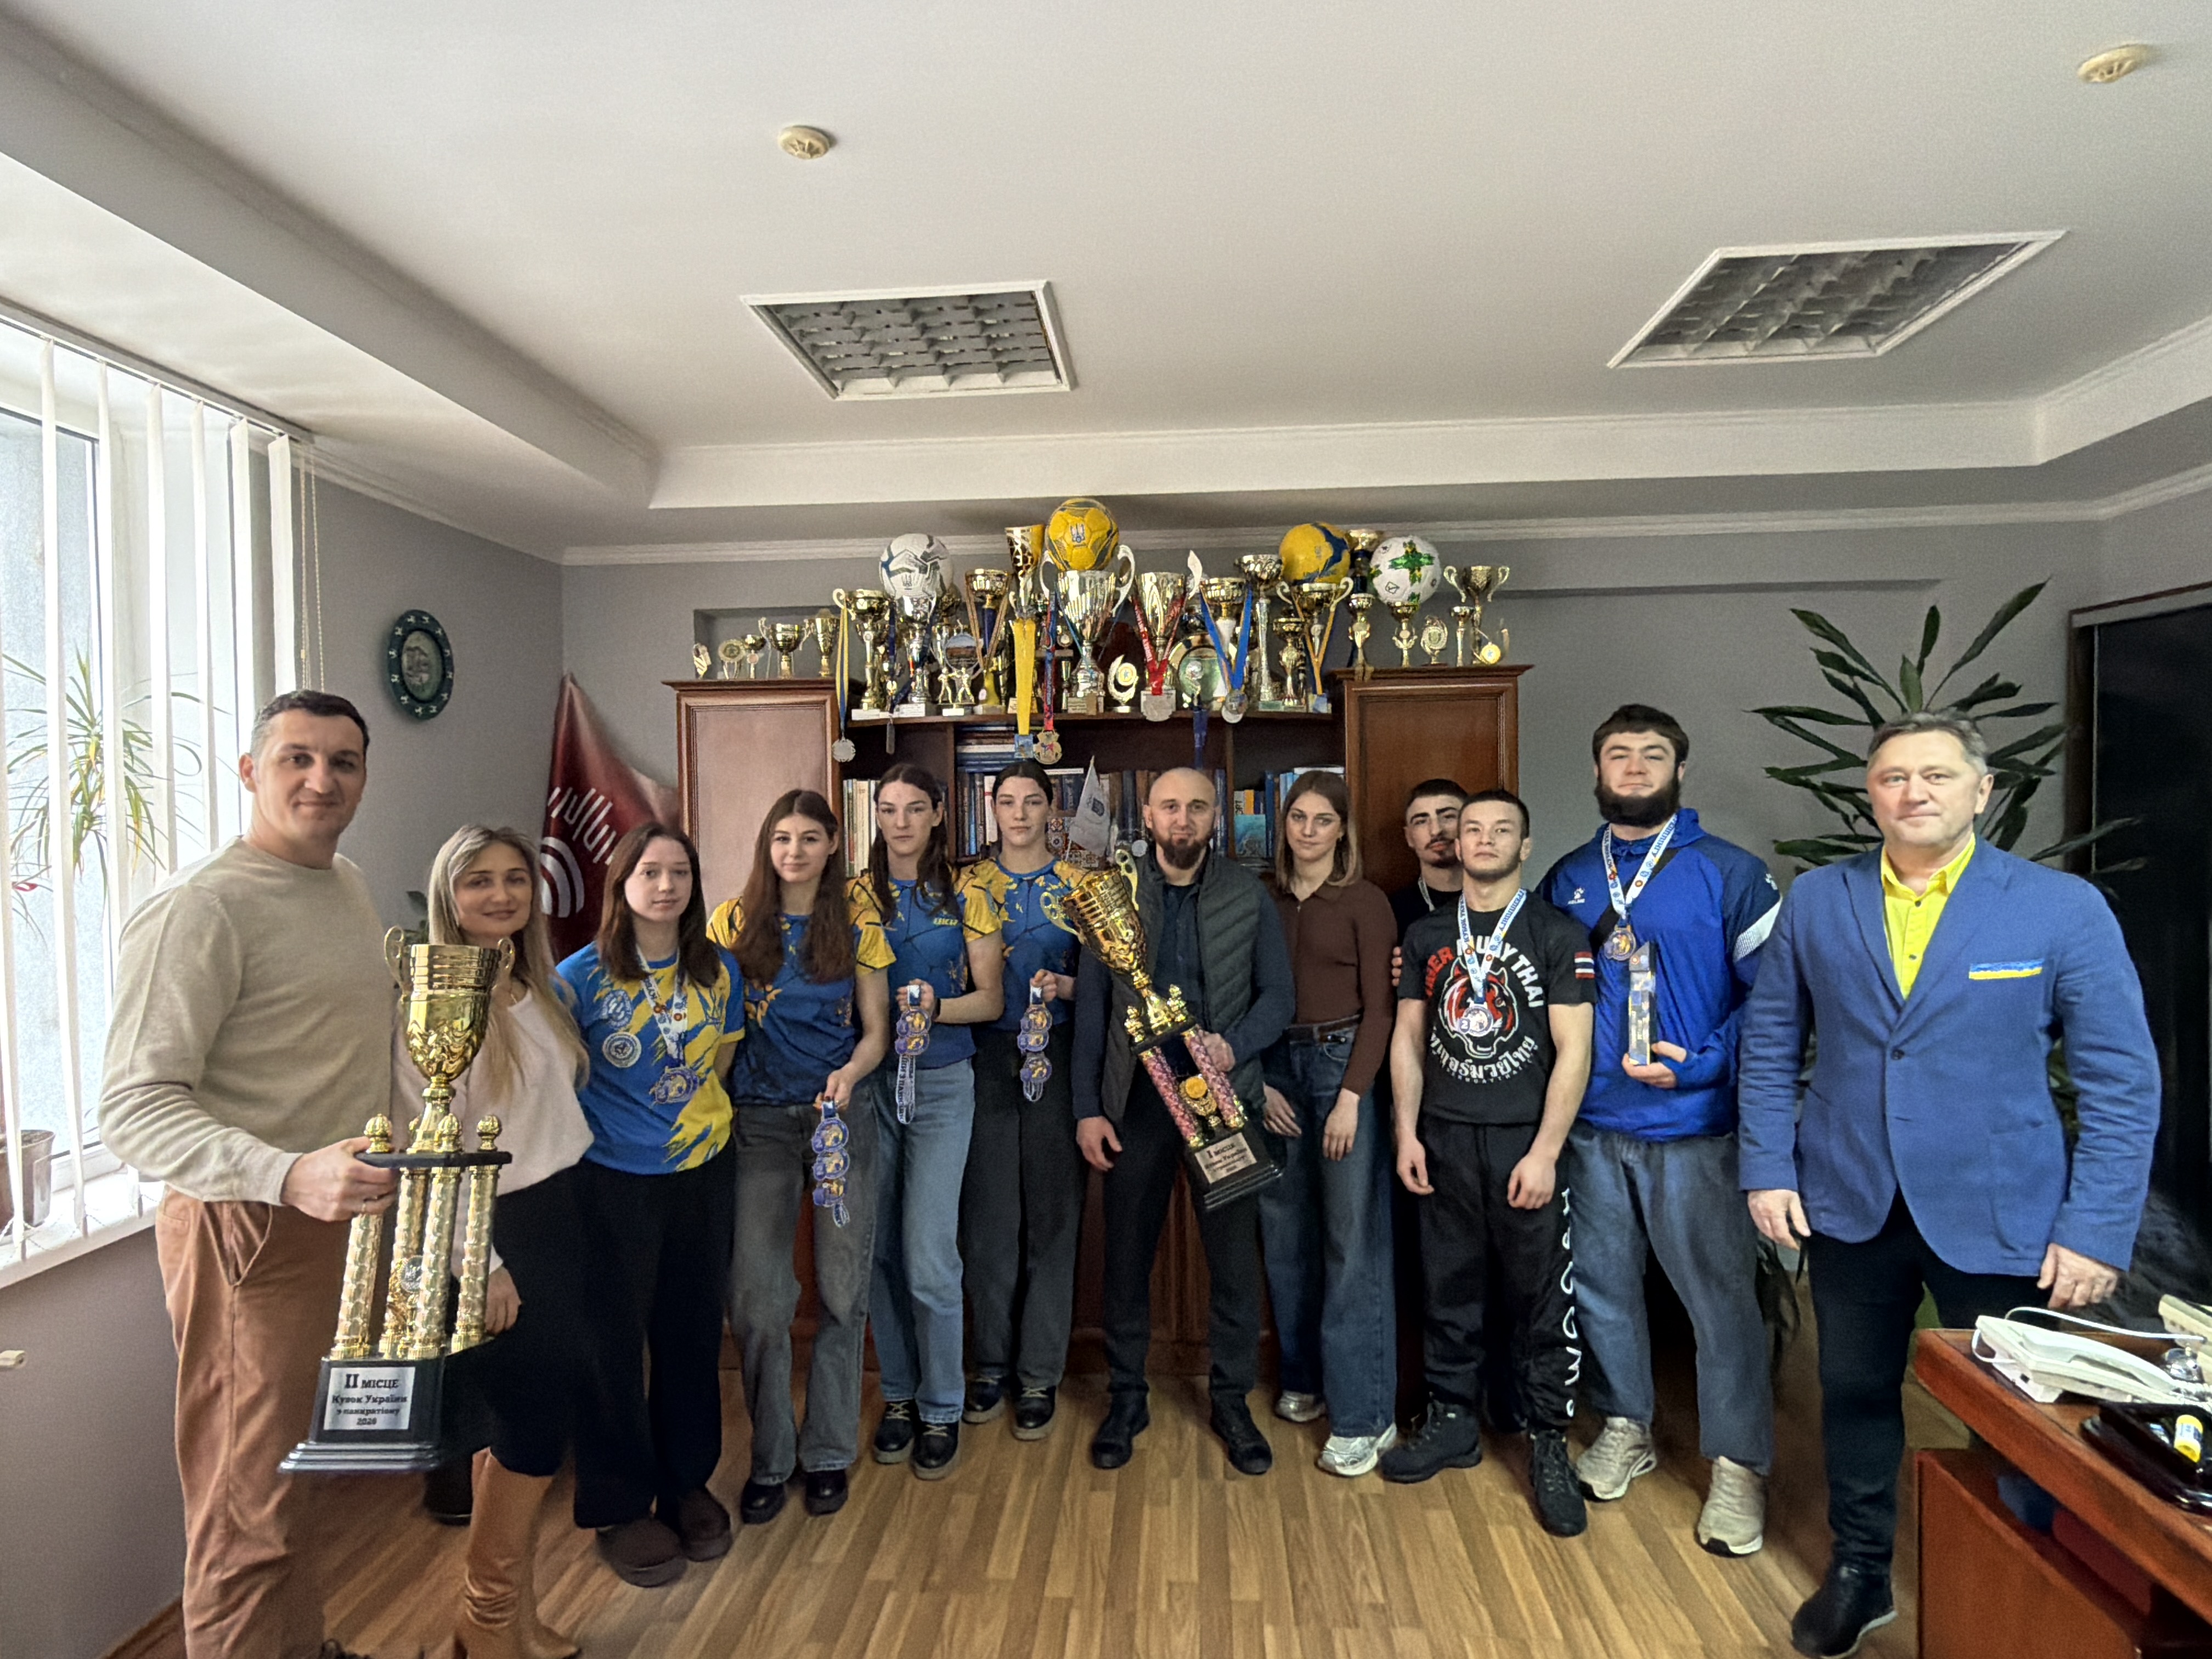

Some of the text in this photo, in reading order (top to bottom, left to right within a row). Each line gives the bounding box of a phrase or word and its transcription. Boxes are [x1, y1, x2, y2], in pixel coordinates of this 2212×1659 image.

[1510, 954, 1544, 1007] THAI
[1461, 1020, 1468, 1029] 2
[361, 1379, 400, 1389] МІСЦЕ
[331, 1393, 408, 1406] Кубок України
